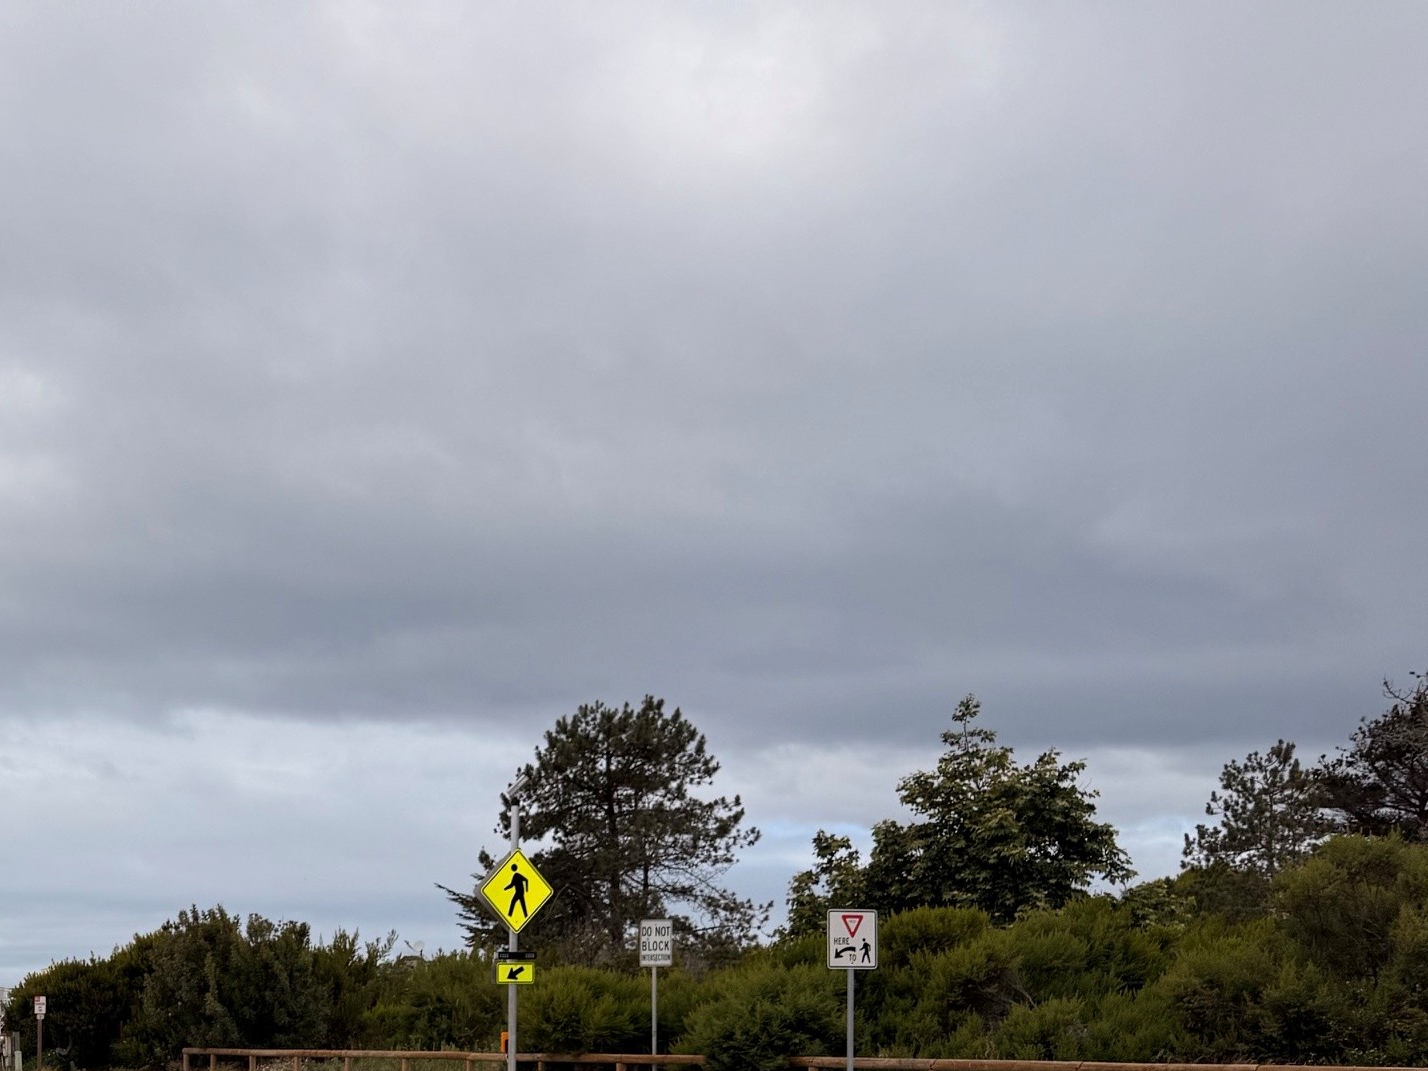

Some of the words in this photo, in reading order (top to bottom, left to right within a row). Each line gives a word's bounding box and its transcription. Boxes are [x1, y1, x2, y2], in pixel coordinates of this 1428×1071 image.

[642, 926, 652, 936] DO
[655, 926, 670, 936] NOT
[833, 937, 850, 945] HERE
[642, 941, 670, 951] BLOCK
[849, 953, 857, 962] TO
